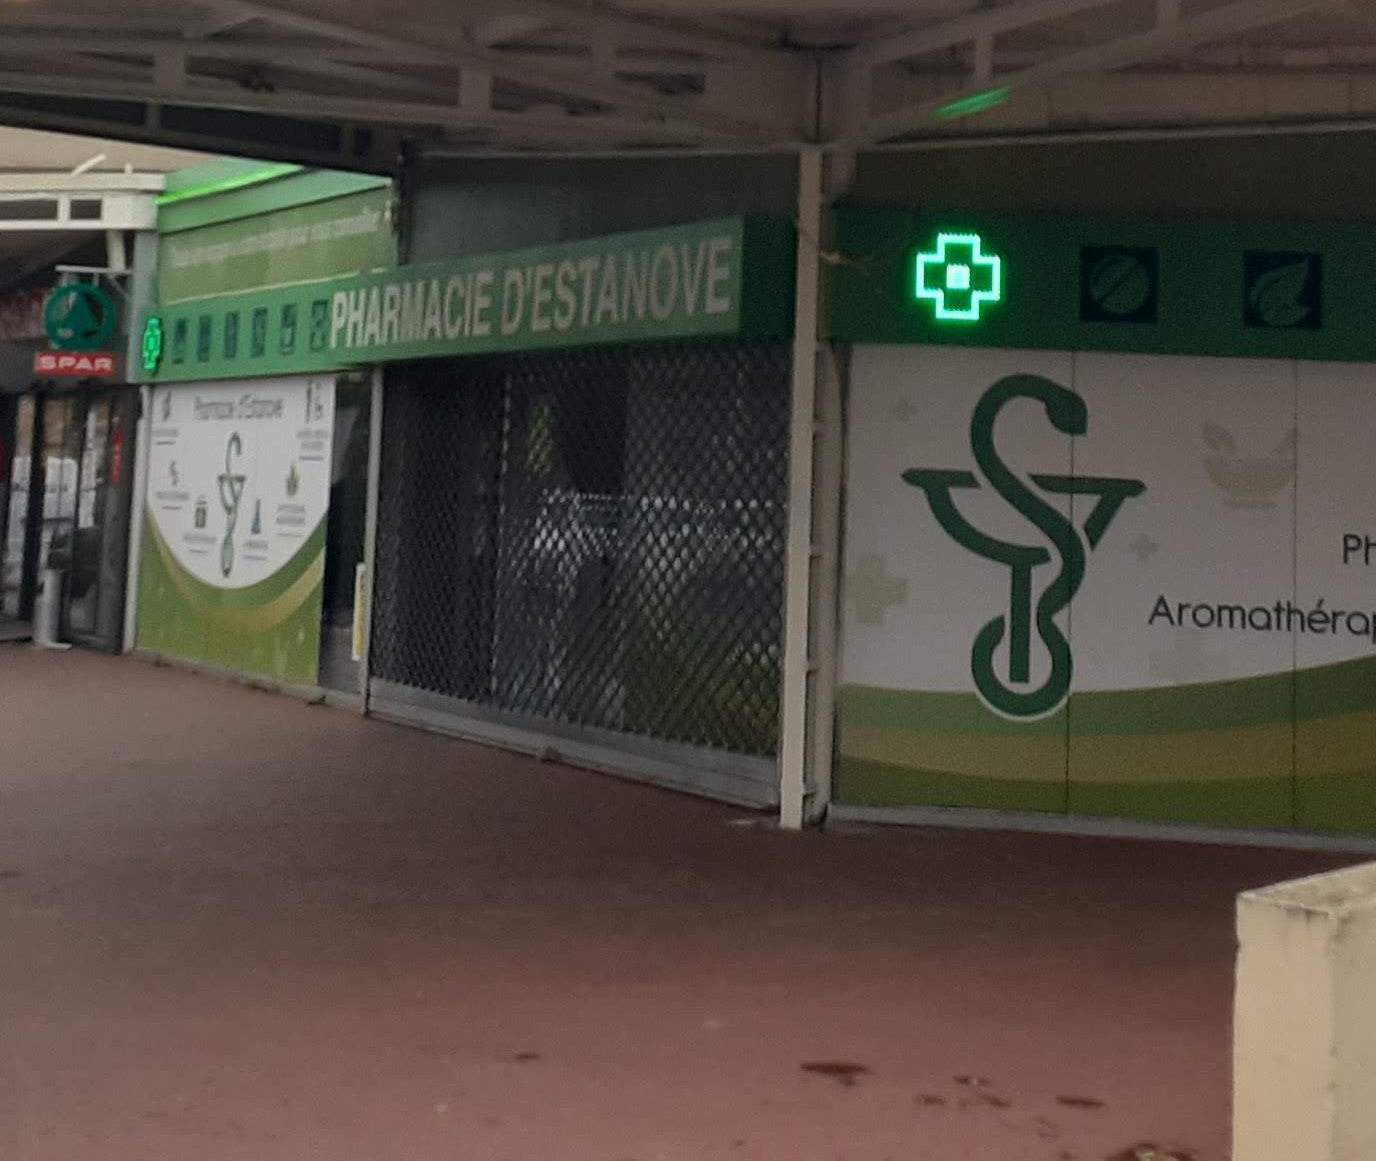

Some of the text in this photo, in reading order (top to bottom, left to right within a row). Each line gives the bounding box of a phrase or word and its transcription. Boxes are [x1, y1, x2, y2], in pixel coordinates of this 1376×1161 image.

[329, 238, 732, 349] PHARMACIE D'ESTANOVE
[39, 354, 113, 371] SPAR
